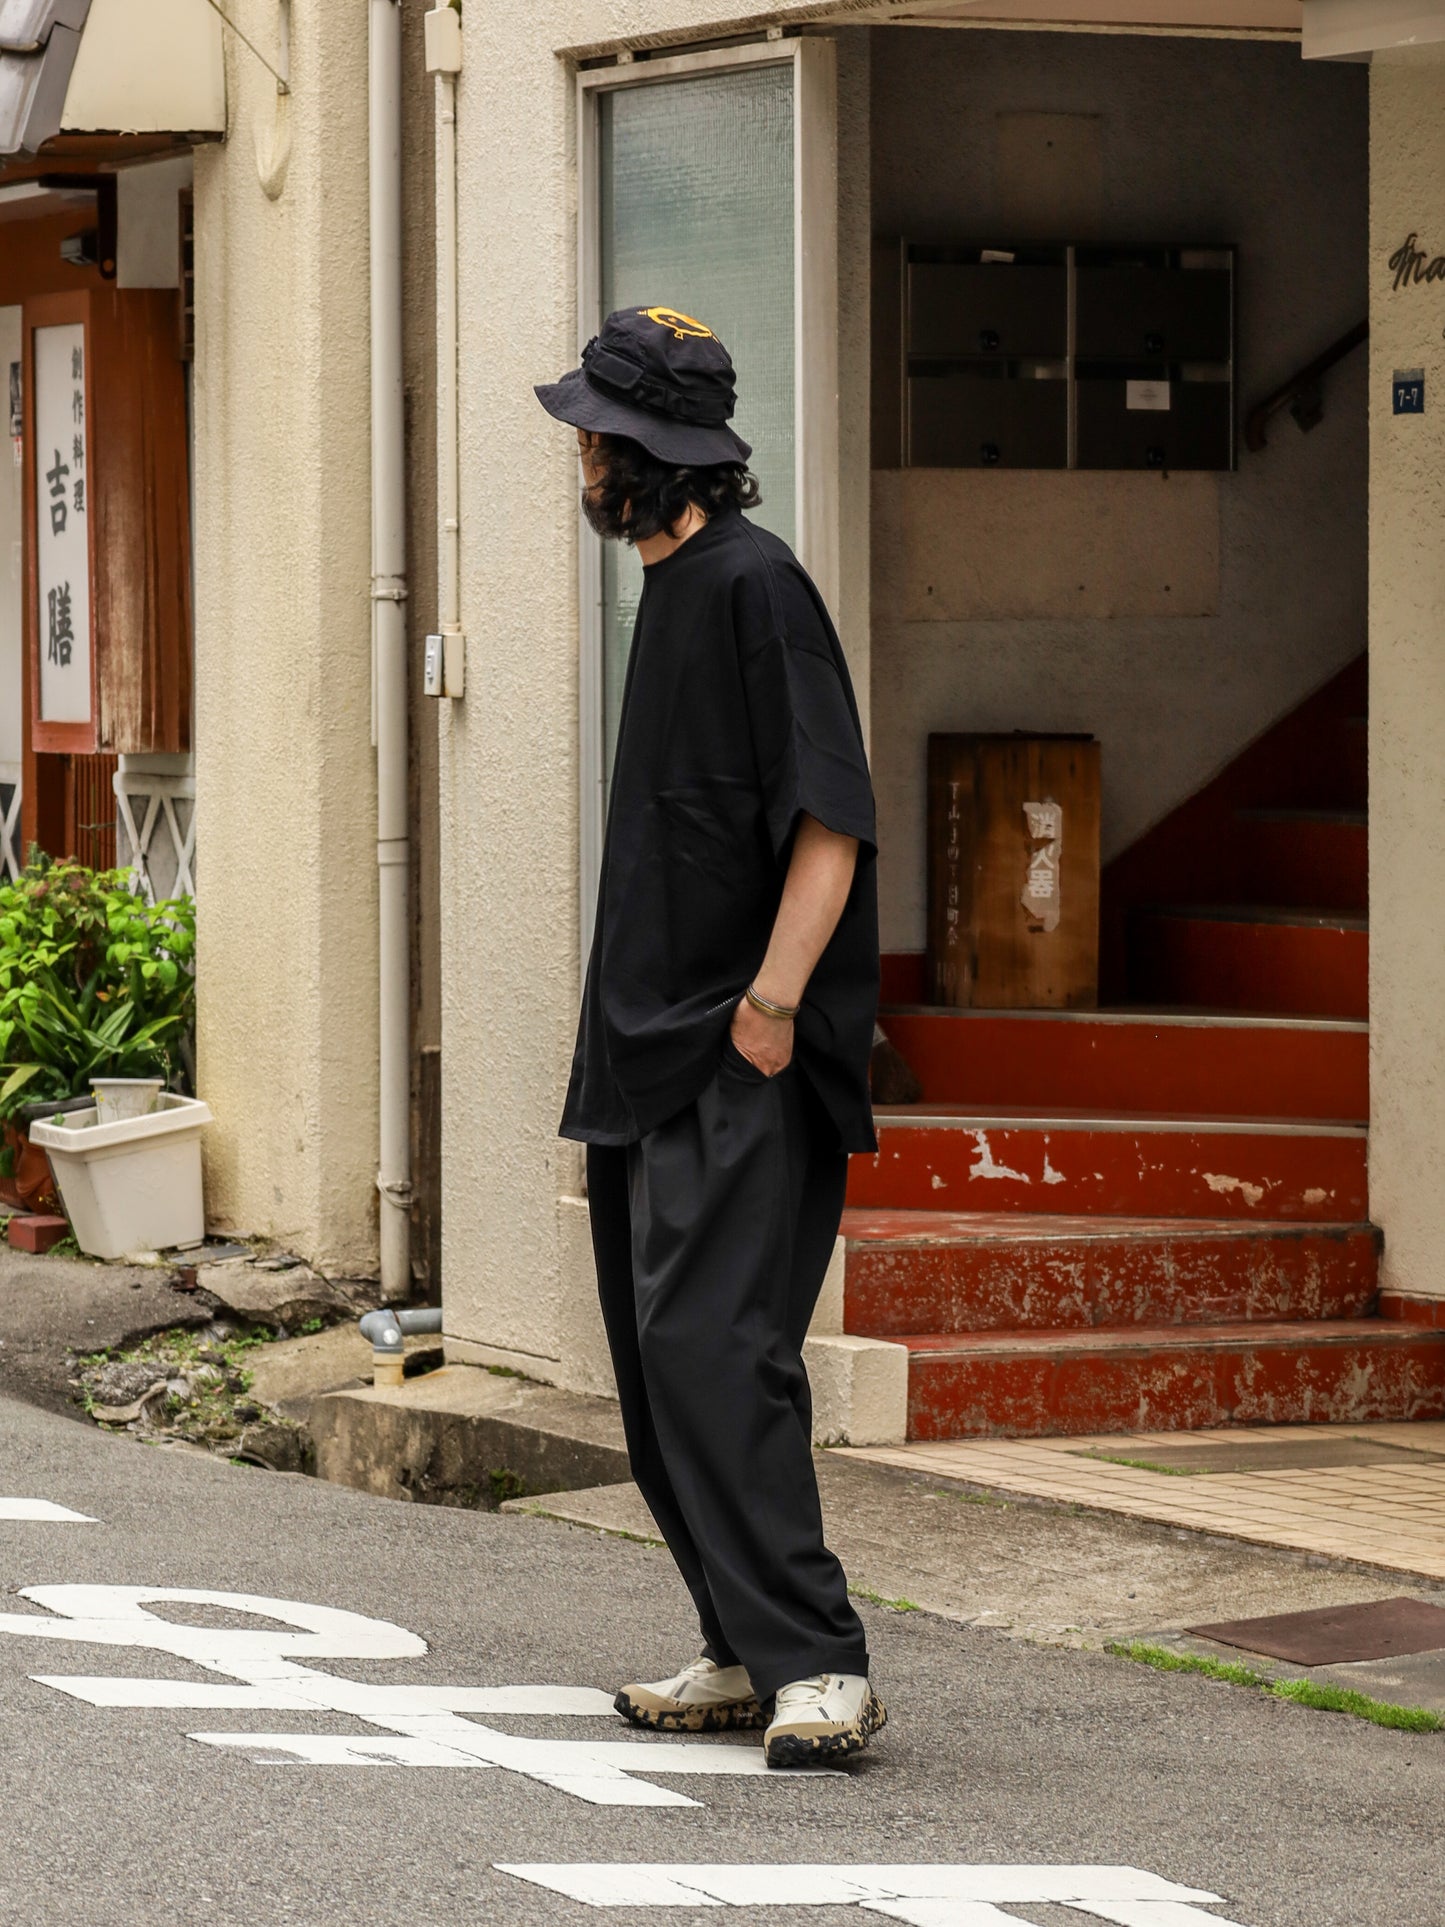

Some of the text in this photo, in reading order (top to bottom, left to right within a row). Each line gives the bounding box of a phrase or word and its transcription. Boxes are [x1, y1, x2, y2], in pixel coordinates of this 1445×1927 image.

[71, 345, 85, 513] 創作料理
[1398, 387, 1418, 408] 7-7
